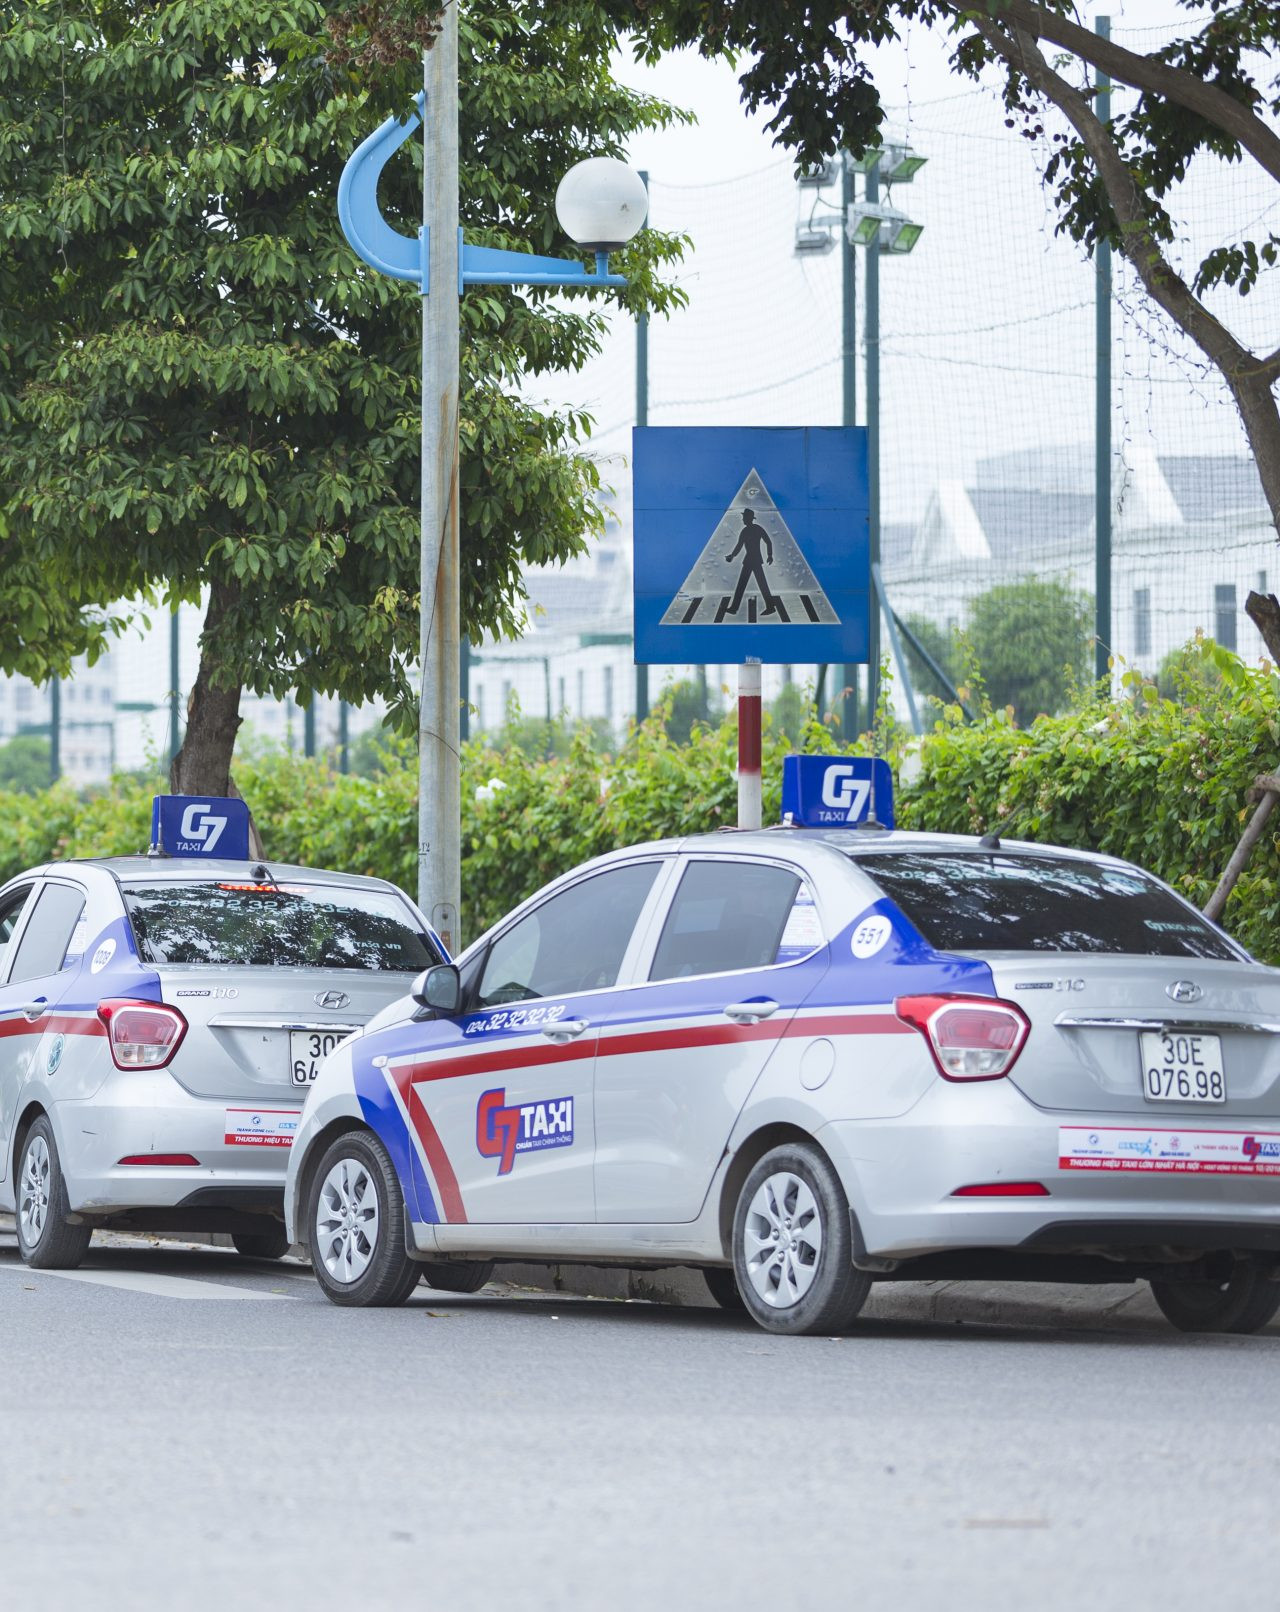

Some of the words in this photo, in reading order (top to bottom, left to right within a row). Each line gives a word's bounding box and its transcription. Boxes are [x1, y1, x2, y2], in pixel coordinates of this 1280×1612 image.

[822, 764, 871, 822] G7
[180, 803, 228, 852] G7
[818, 811, 845, 822] TAXI
[176, 842, 201, 851] TAXI
[248, 900, 279, 911] 32
[857, 928, 884, 945] 551
[212, 986, 239, 999] i10
[1161, 1034, 1204, 1067] 30E
[293, 1060, 319, 1083] 64
[1148, 1068, 1223, 1099] 076.98
[476, 1087, 521, 1176] G7
[520, 1100, 572, 1138] TAXI
